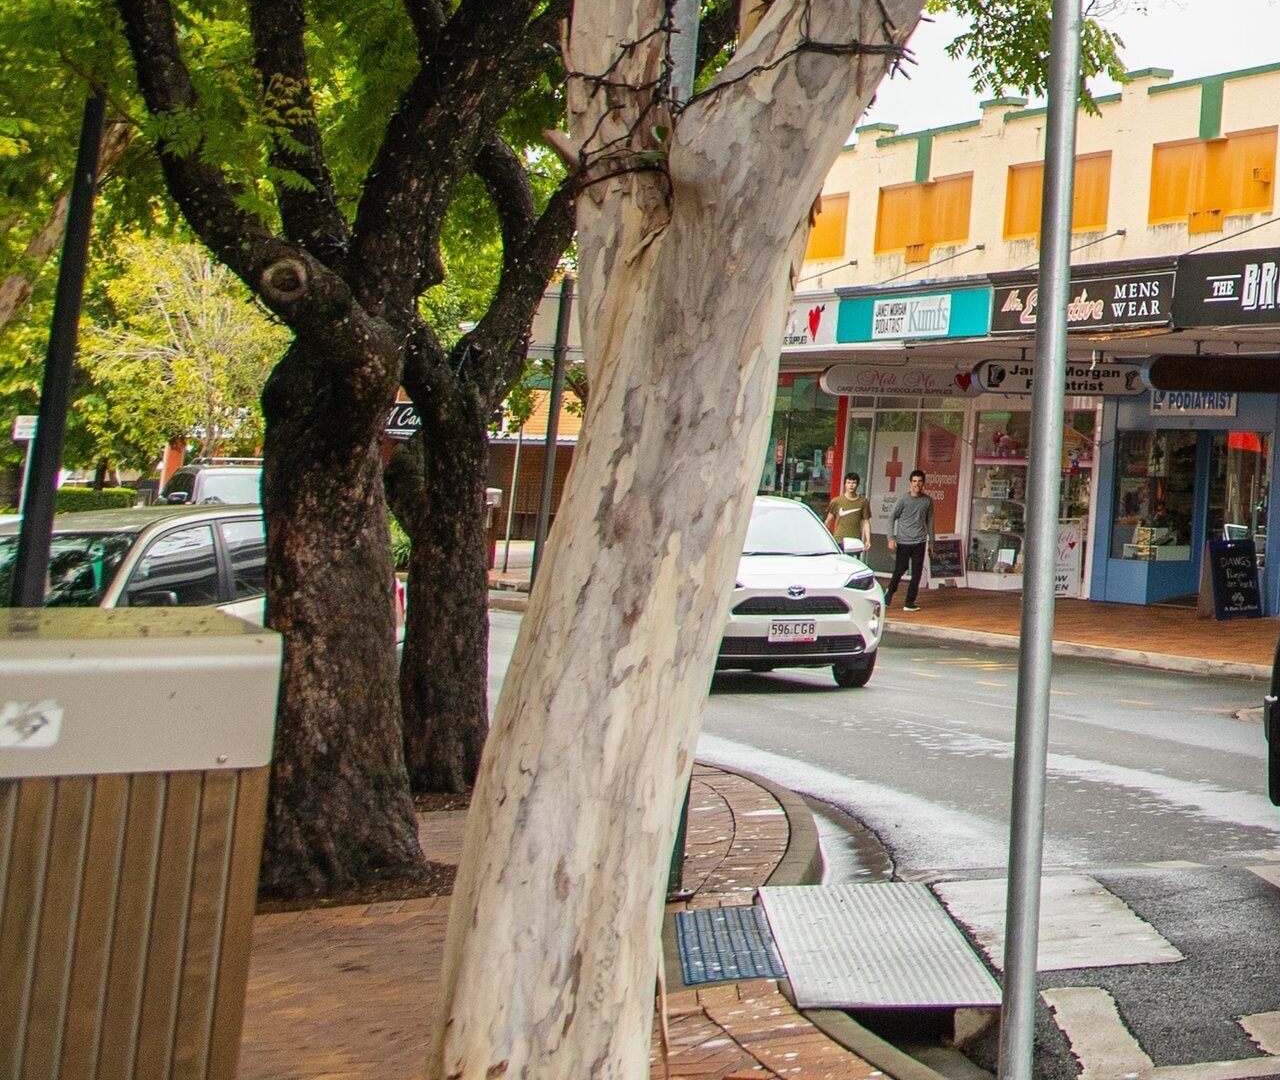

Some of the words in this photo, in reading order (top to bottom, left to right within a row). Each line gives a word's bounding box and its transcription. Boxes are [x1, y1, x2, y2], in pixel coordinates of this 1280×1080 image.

[1114, 281, 1160, 299] MENS
[1212, 279, 1234, 296] THE
[908, 297, 949, 332] Kumfs
[1111, 300, 1161, 317] WEAR
[1168, 392, 1233, 410] PODIATRIST
[924, 471, 958, 487] mployment
